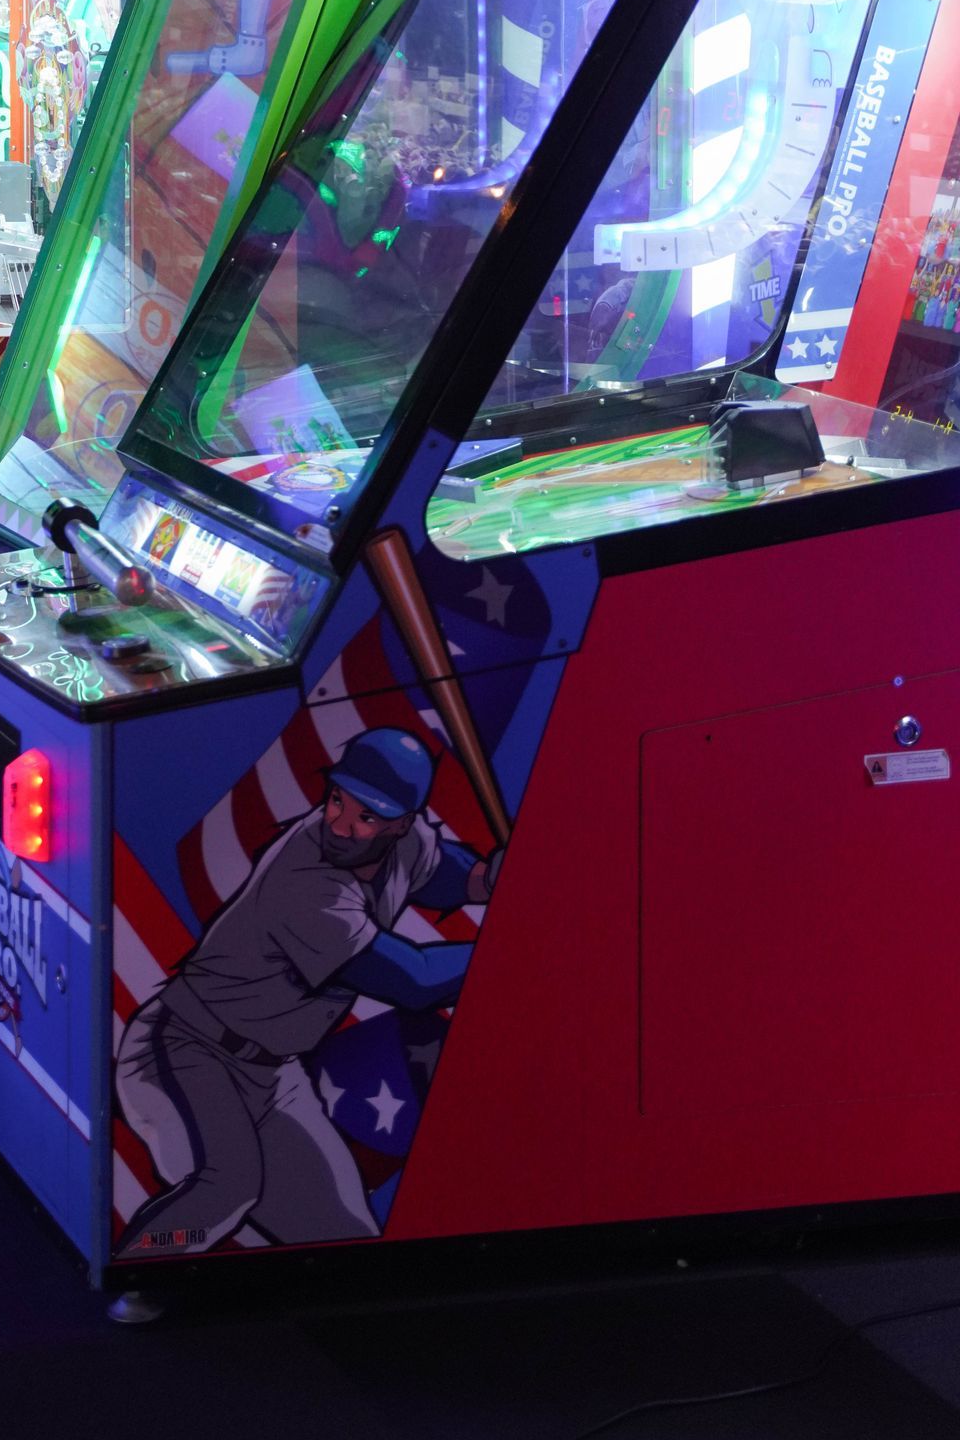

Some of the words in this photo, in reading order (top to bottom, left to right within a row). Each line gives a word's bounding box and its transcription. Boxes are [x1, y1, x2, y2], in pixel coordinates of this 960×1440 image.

[842, 44, 897, 177] BASEBALL
[824, 183, 859, 241] PRO.
[748, 277, 781, 303] TIME
[141, 1228, 208, 1250] ANDAMIRO
